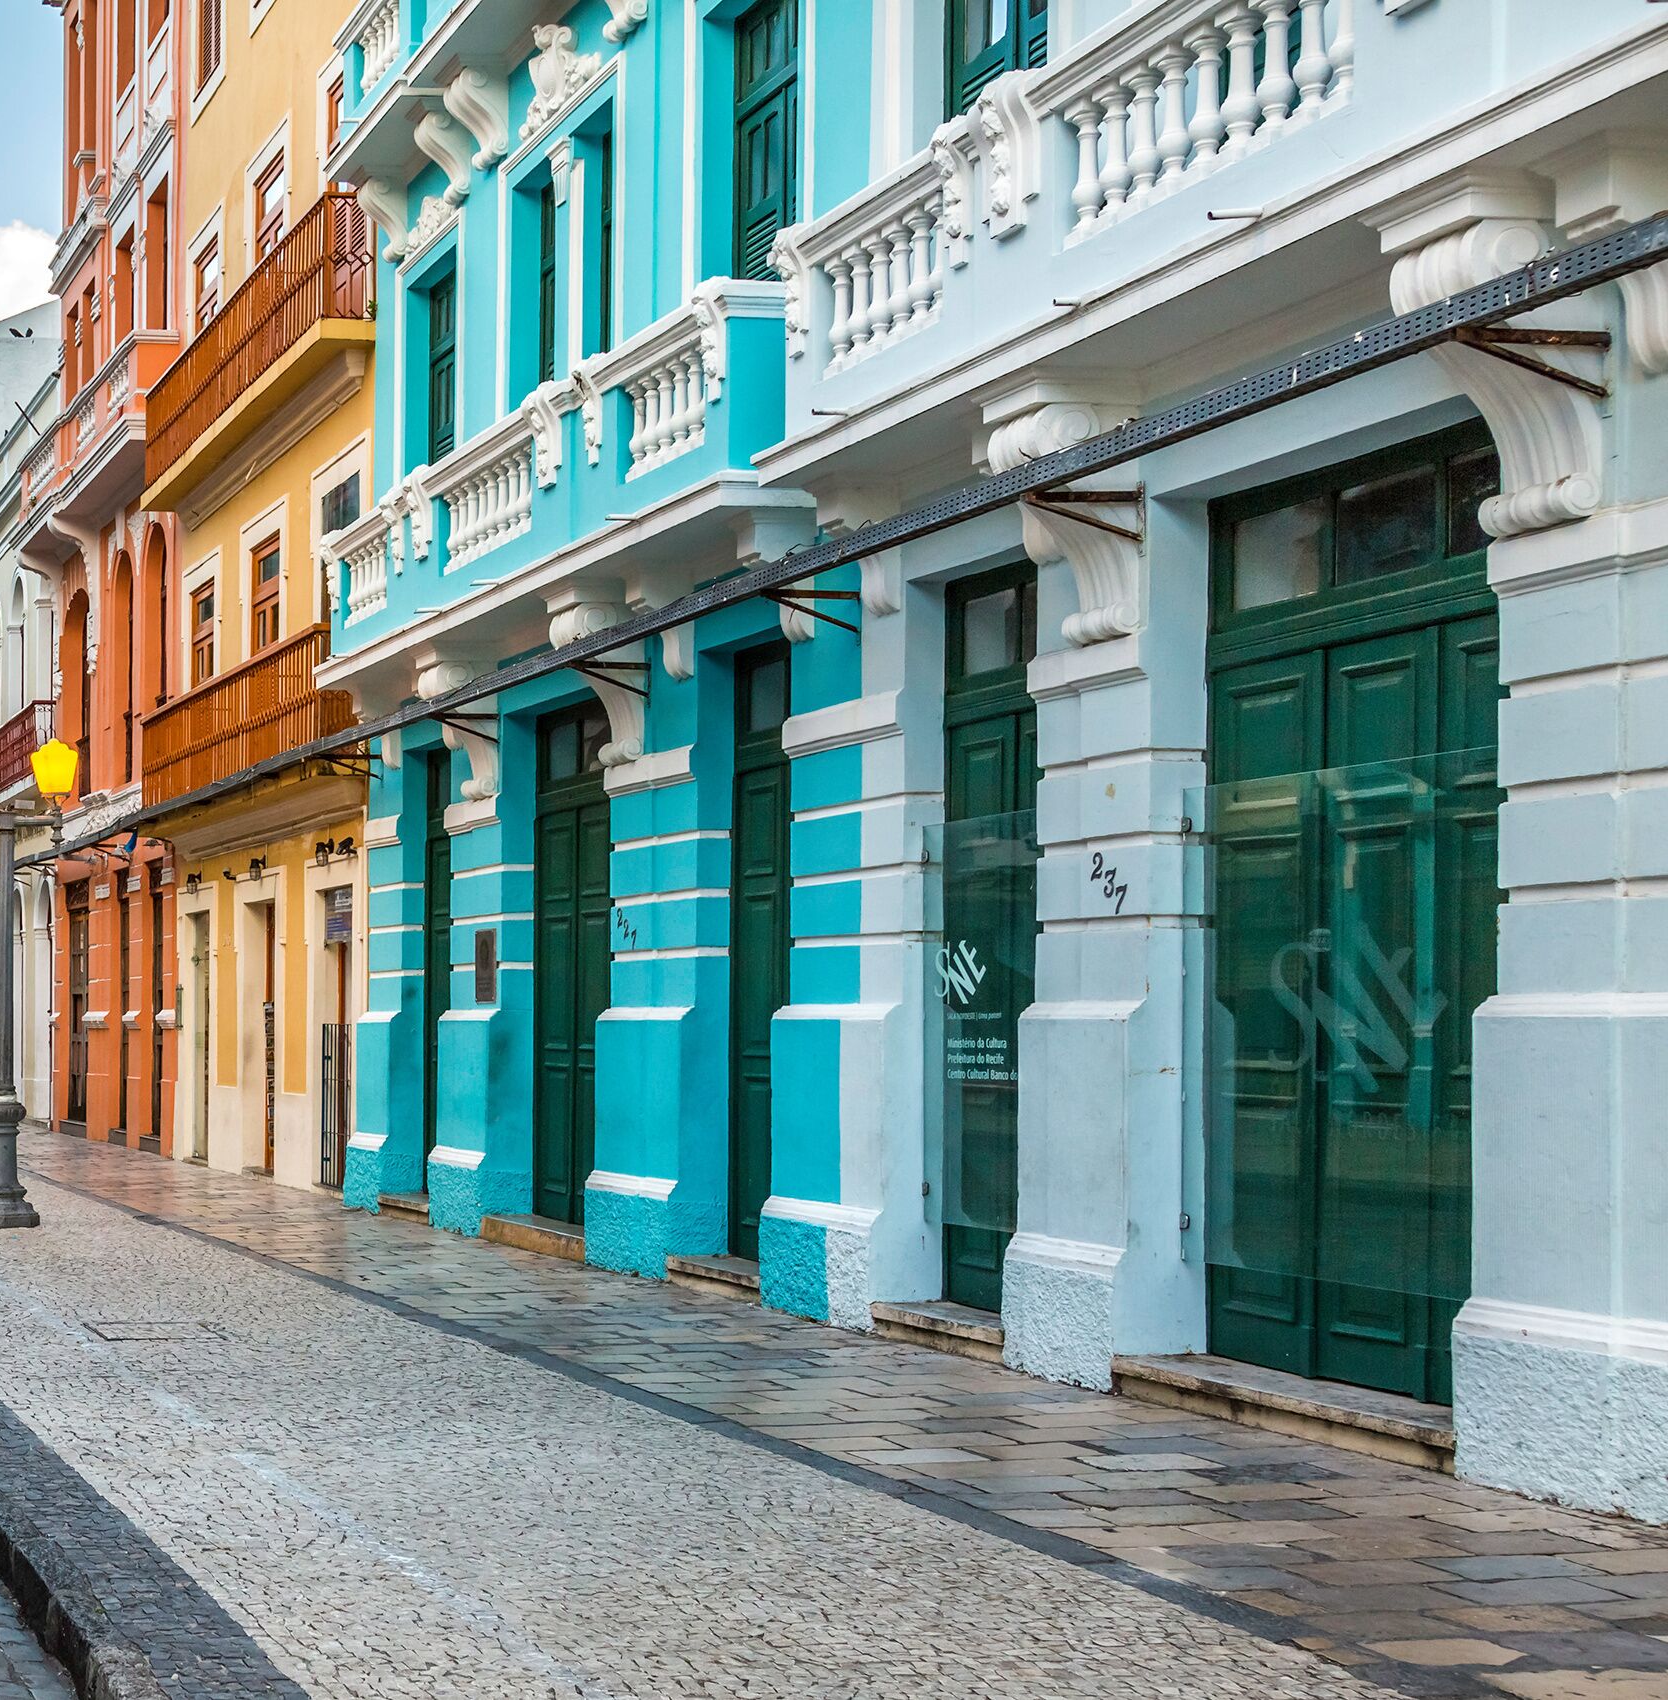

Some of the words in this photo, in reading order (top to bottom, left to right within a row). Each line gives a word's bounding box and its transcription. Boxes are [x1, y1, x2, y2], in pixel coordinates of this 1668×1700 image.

[1090, 851, 1128, 915] 237
[616, 907, 637, 950] 227
[947, 1037, 976, 1049] Ministério
[977, 1037, 984, 1049] da
[985, 1037, 1007, 1049] Cultura
[947, 1053, 976, 1064] Prefeitura
[977, 1053, 984, 1064] do
[985, 1053, 1005, 1065] Recife
[947, 1068, 966, 1079] Centro
[967, 1068, 990, 1080] Cultural
[990, 1069, 1009, 1081] Banco
